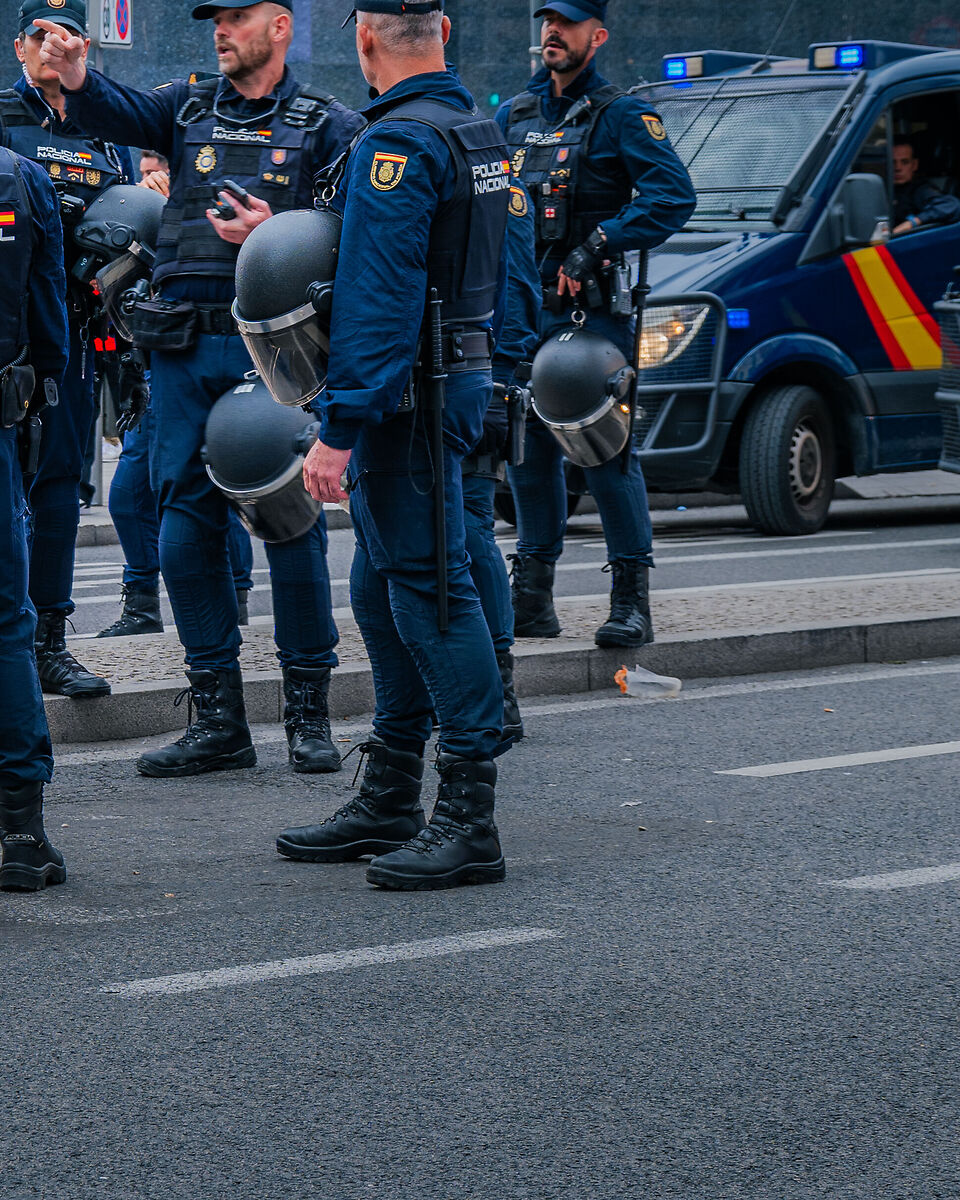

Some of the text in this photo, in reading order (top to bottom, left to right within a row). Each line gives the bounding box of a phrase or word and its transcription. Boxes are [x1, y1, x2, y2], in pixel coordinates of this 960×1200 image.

[37, 146, 80, 158] POLICIA
[37, 152, 92, 166] NACIONAL
[472, 161, 507, 179] POLICIA
[474, 176, 511, 195] NACIONAL
